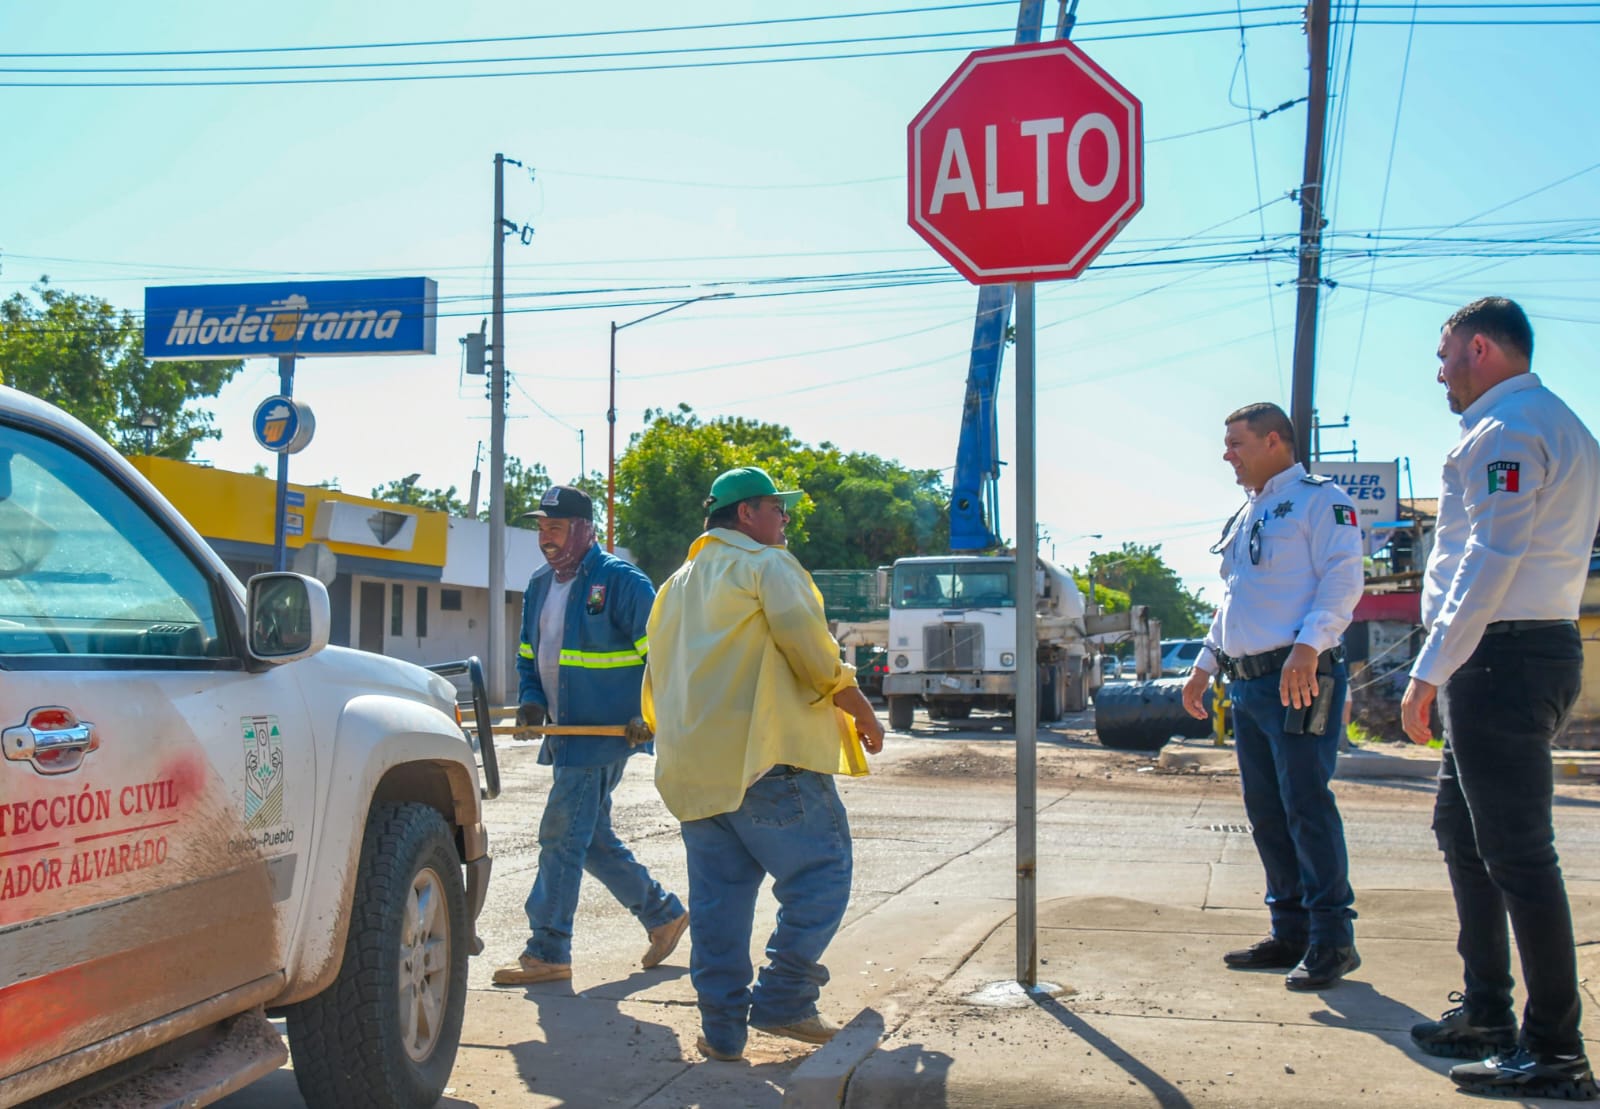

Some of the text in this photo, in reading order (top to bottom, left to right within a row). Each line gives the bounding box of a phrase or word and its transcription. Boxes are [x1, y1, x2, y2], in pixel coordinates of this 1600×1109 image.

[929, 112, 1121, 215] ALTO
[119, 780, 179, 822] CIVIL
[263, 828, 294, 847] Pueblo
[0, 836, 168, 900] ADOR ALVARADO
